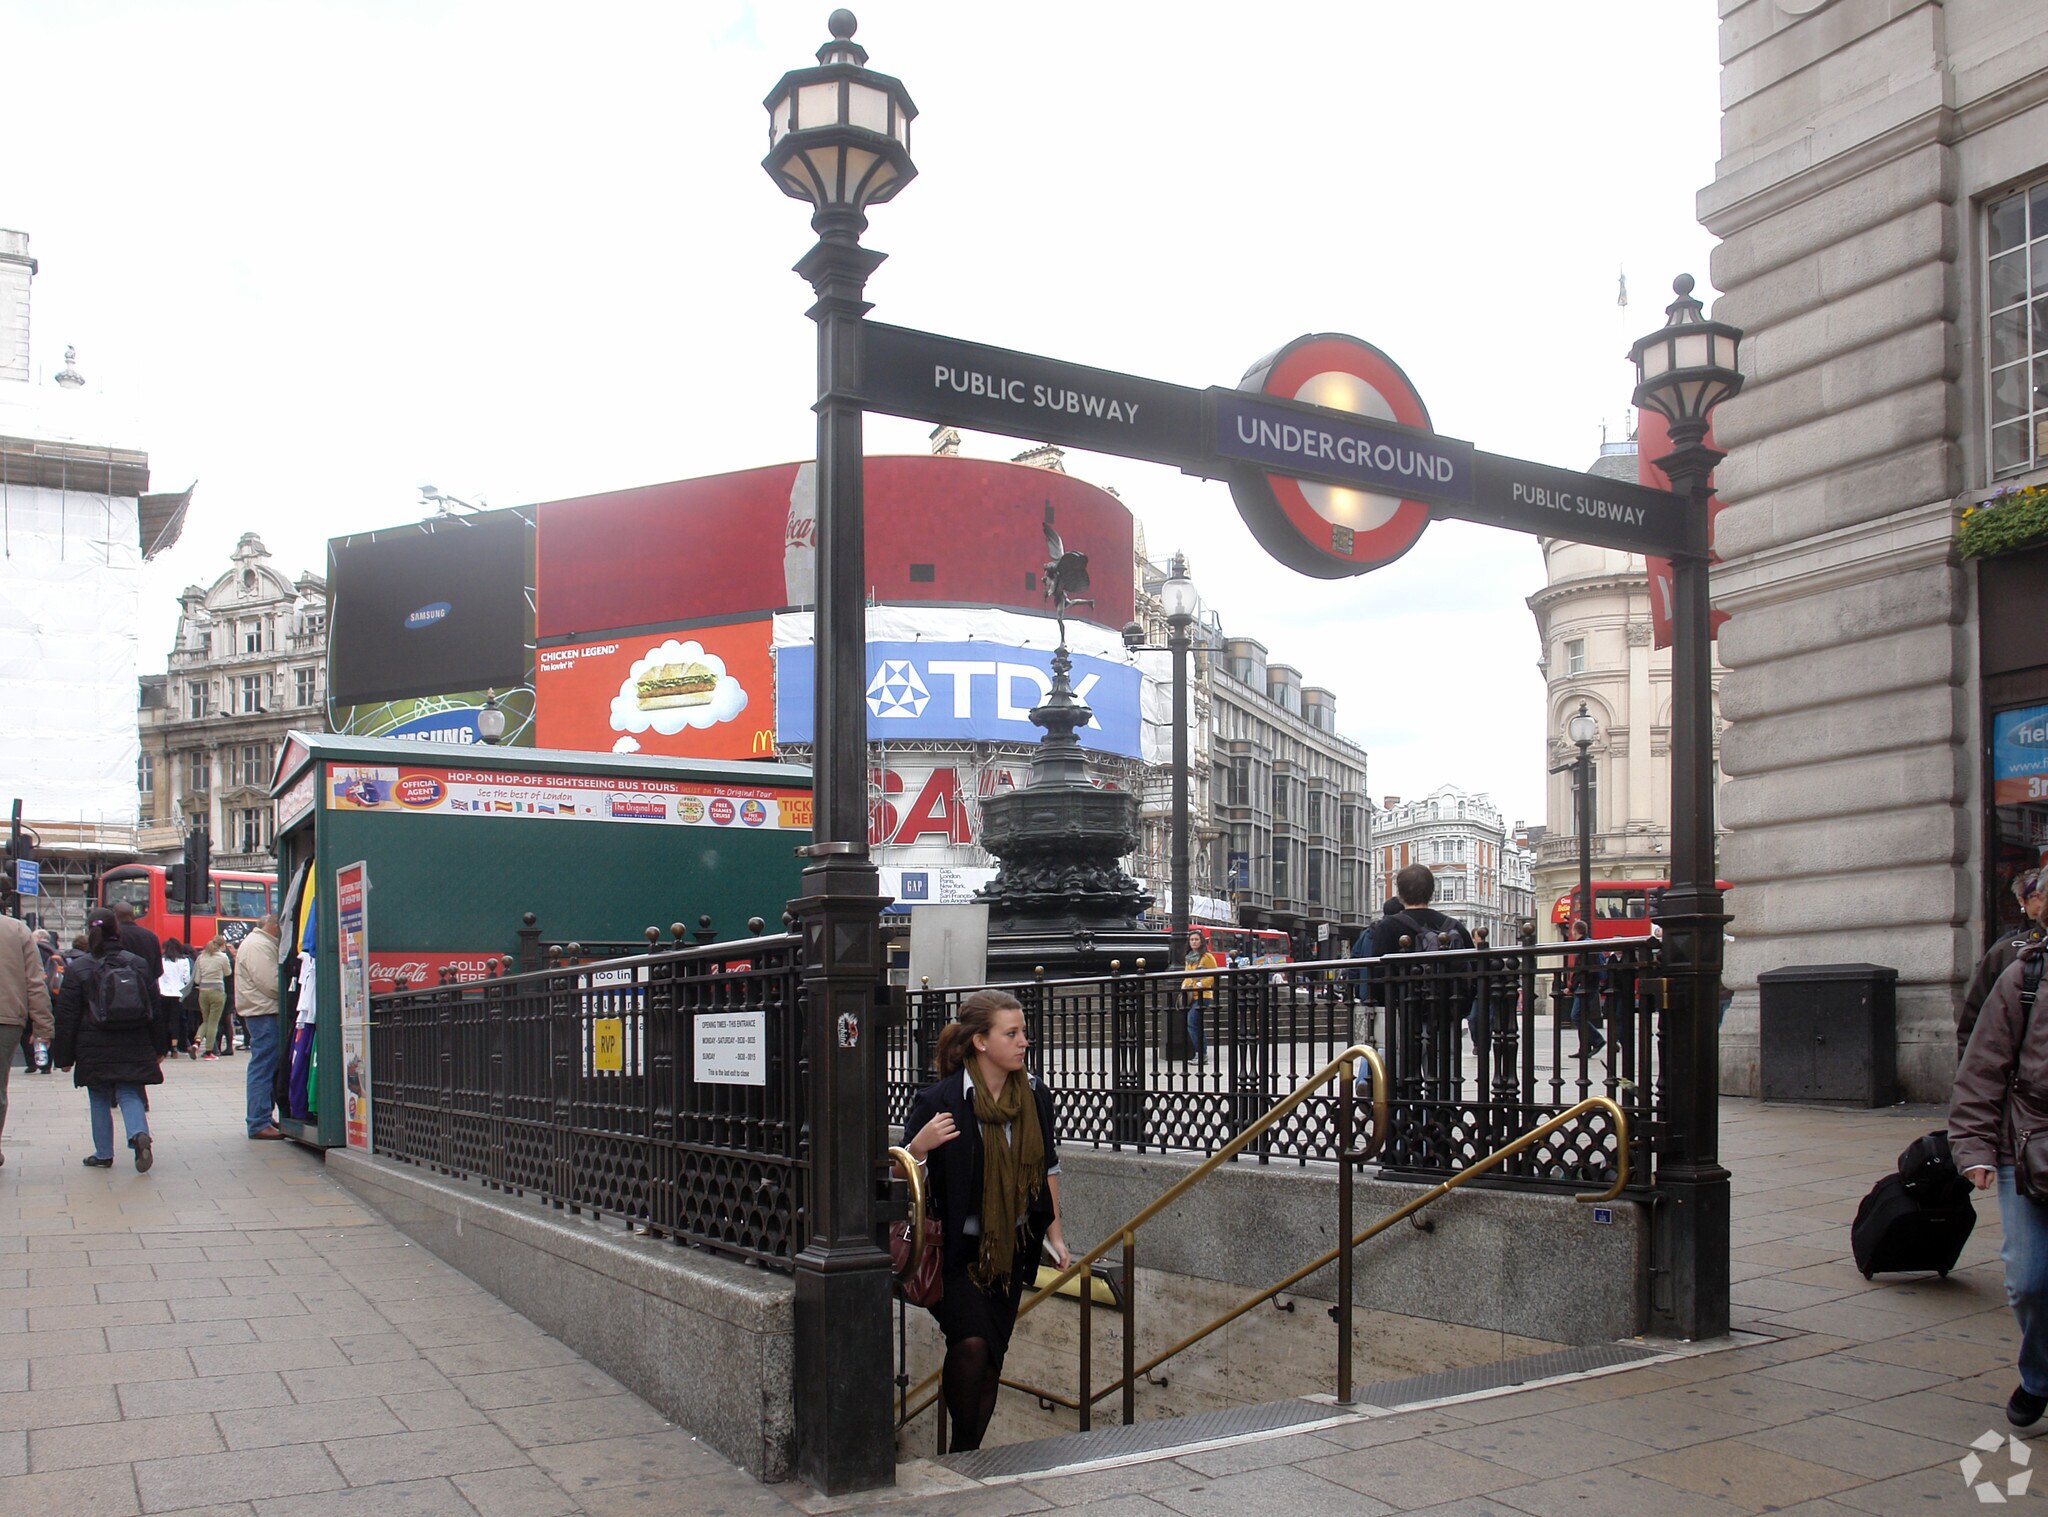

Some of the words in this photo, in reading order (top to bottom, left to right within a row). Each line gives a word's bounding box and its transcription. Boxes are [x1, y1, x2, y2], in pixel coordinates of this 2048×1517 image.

[934, 364, 1025, 404] PUBLIC
[1033, 384, 1139, 425] SUBWAY
[1237, 415, 1454, 482] UNDERGROUND
[1512, 482, 1572, 512] PUBLIC
[1576, 496, 1646, 526] SUBWAY
[410, 608, 446, 622] SAMSUNG
[540, 649, 579, 662] CHICKEN
[927, 660, 1102, 730] TDK
[402, 780, 438, 788] OFFICIAL
[447, 772, 493, 783] HOP-ON
[496, 774, 544, 785] HOP-OFF
[546, 777, 615, 788] SIGHTSEEING
[618, 781, 639, 790] BUS
[641, 782, 679, 792] TOURS:
[712, 787, 726, 796] The
[726, 790, 754, 798] Original
[756, 790, 773, 798] Tour
[407, 788, 435, 796] AGENT
[476, 788, 491, 797] See
[493, 789, 508, 798] the
[510, 790, 530, 799] best
[530, 790, 542, 800] of
[543, 792, 573, 801] London
[614, 802, 625, 811] The
[626, 804, 650, 814] Original
[651, 804, 664, 812] Tour
[907, 880, 923, 892] GAP
[368, 962, 430, 982] Coca-Cola
[450, 960, 486, 971] SOLD
[737, 1020, 756, 1028] ENTRANCE
[600, 1035, 616, 1054] RVP
